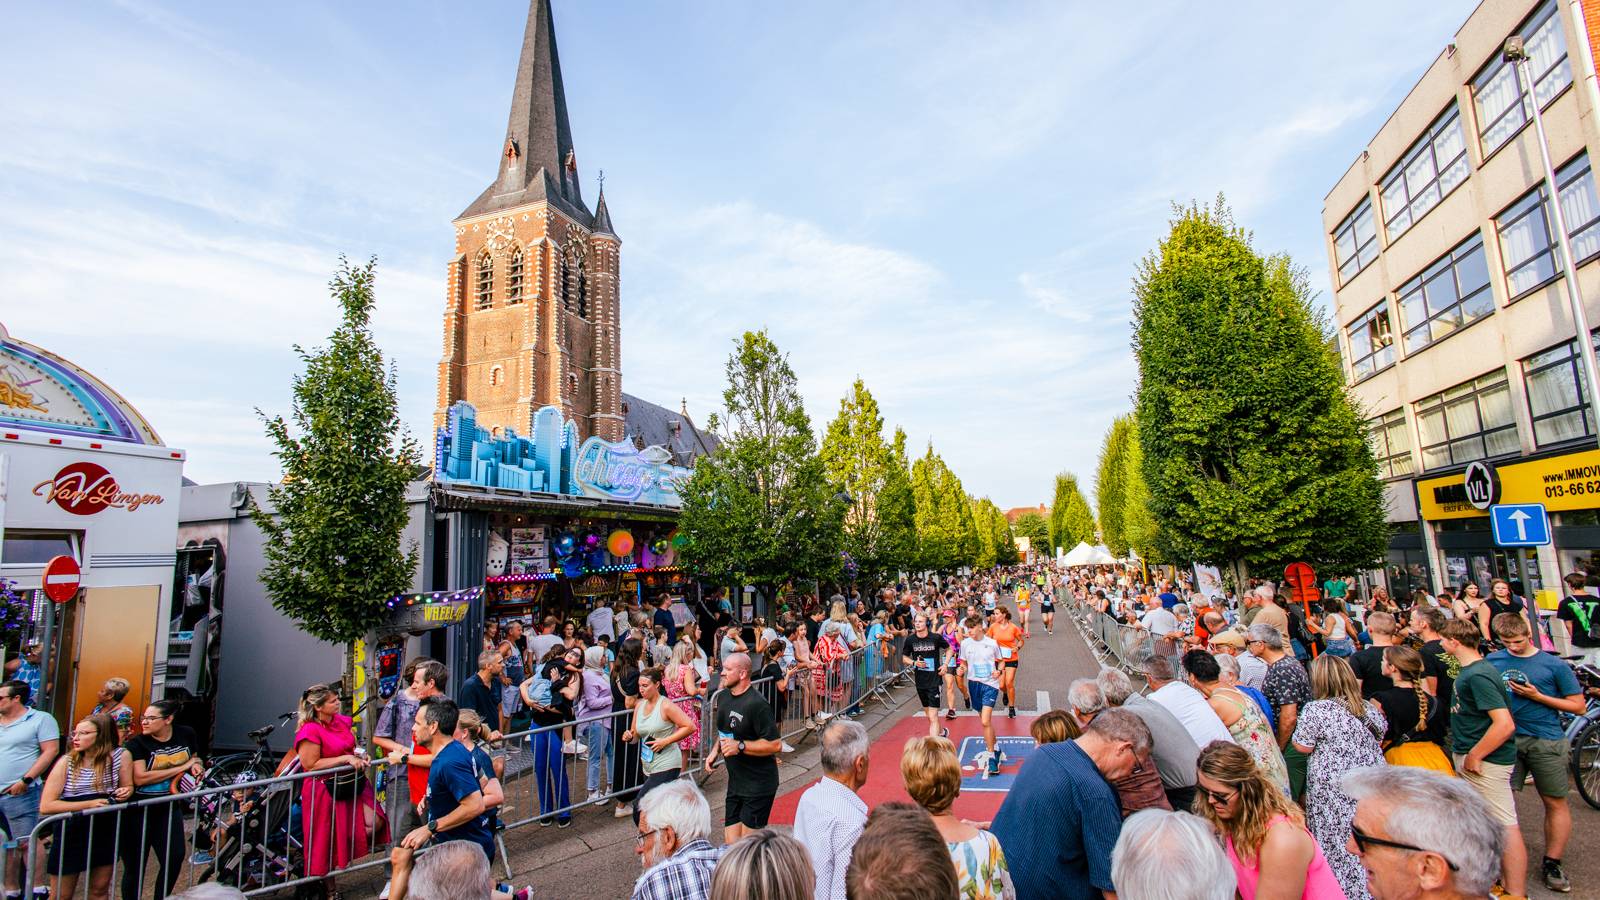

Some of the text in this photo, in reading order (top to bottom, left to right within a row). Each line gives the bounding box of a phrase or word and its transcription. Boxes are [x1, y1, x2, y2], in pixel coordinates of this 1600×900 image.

[32, 479, 165, 512] Van Lingen
[1470, 480, 1488, 500] VL
[1545, 480, 1600, 498] 013-66 62
